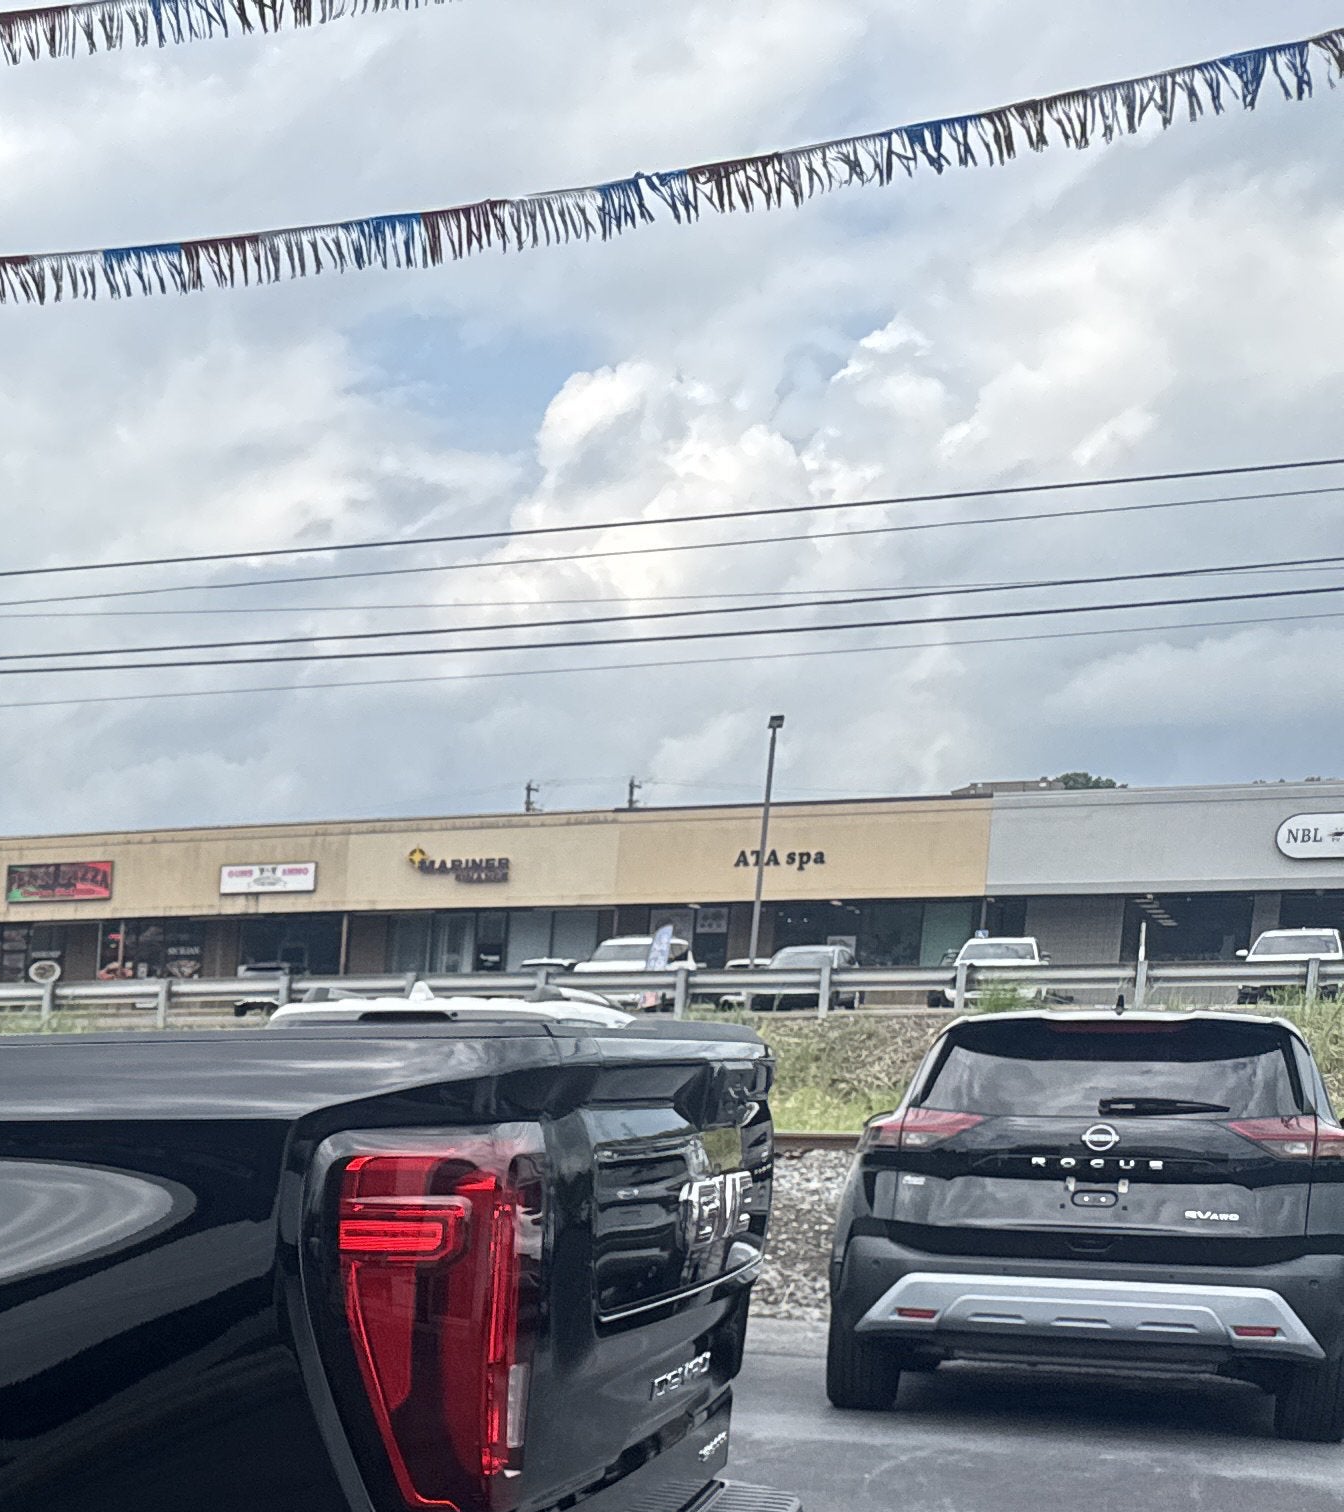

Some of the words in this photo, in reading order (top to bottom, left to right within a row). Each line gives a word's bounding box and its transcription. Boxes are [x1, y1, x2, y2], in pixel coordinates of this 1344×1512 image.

[1286, 827, 1323, 844] NBL
[418, 857, 510, 875] MARINER
[786, 851, 826, 871] spa
[1031, 1156, 1164, 1171] ROGUE
